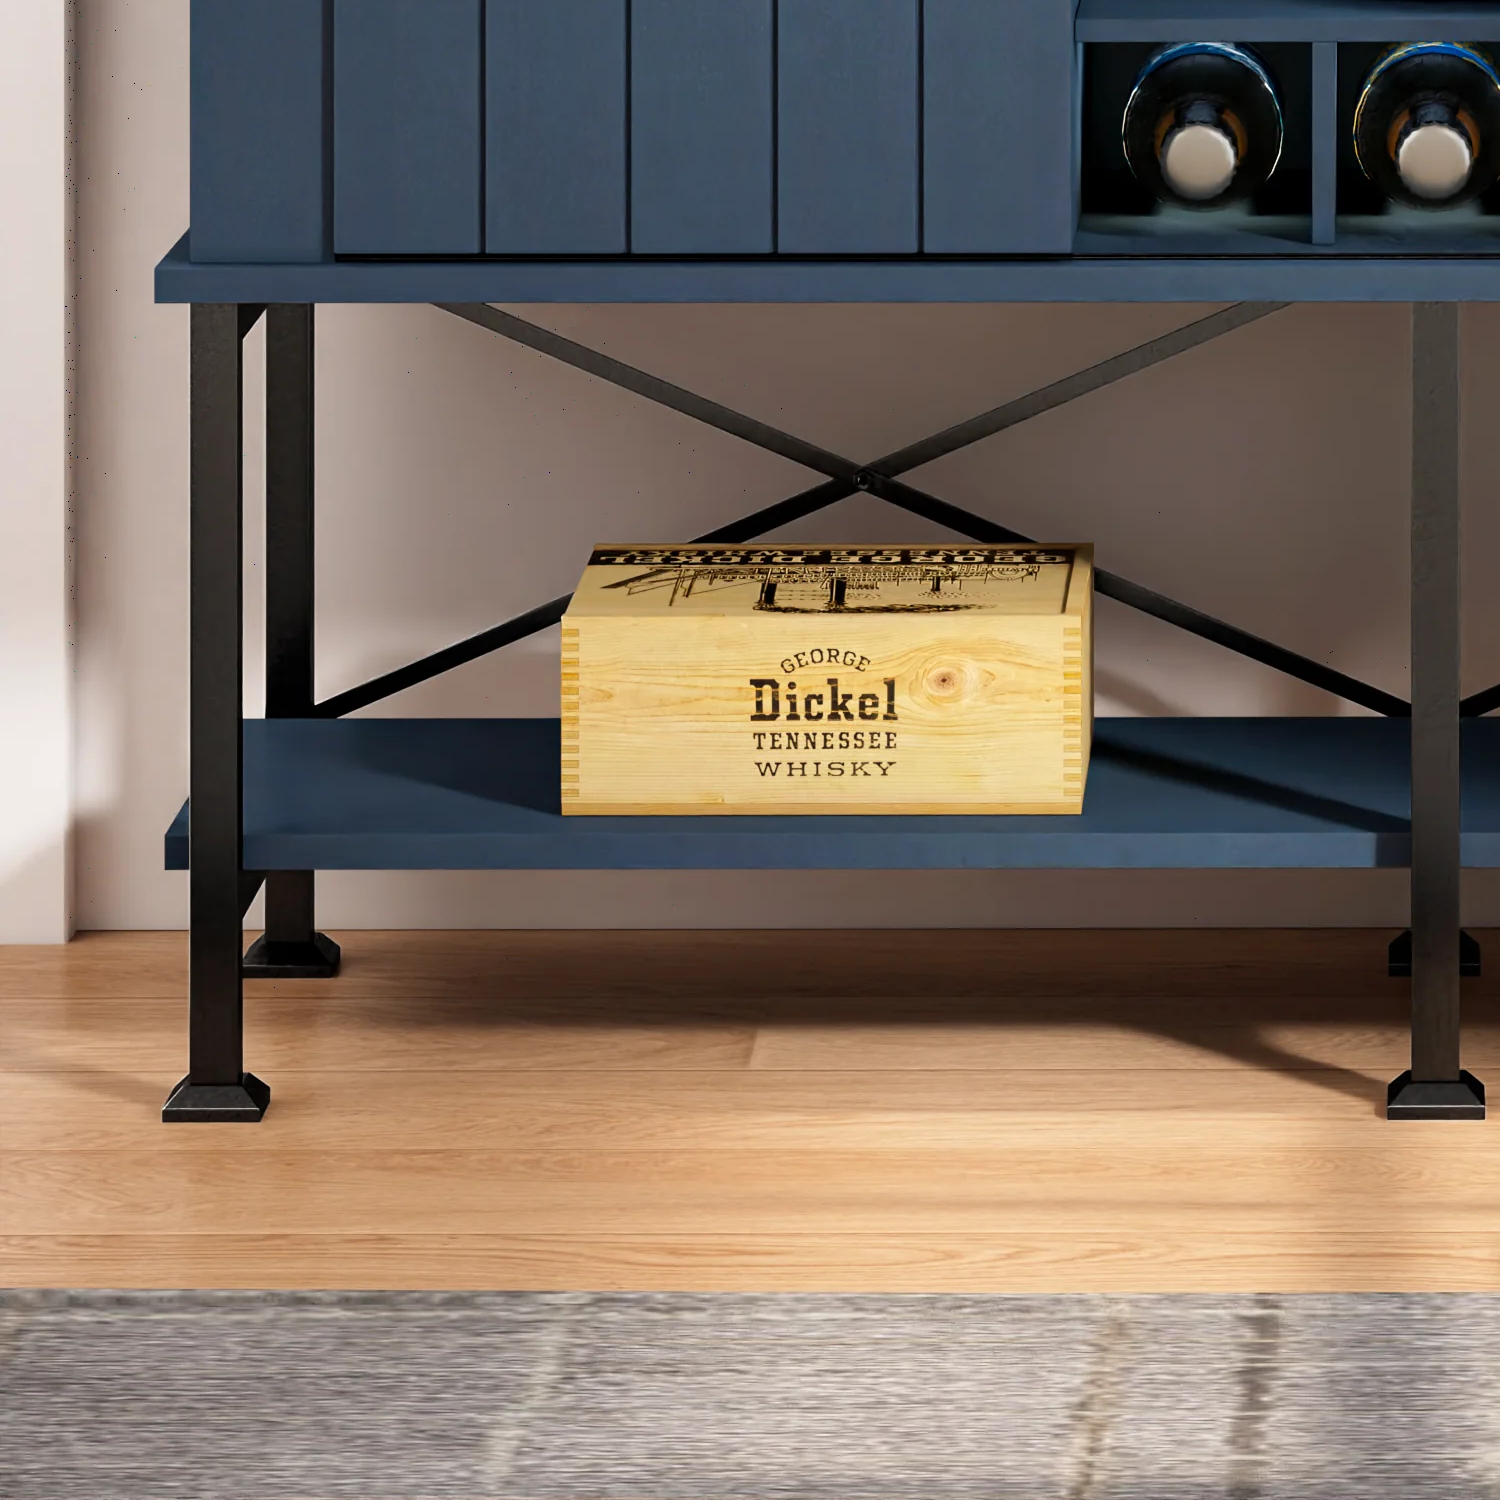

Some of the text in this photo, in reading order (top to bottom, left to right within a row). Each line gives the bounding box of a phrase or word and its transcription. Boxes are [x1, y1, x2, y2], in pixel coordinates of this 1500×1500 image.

[600, 555, 1066, 563] GEORGE DICKEL
[780, 648, 871, 674] GEORGE
[750, 677, 898, 721] Dickel
[753, 731, 897, 750] TENNESSEE
[754, 761, 897, 777] WHISKY
